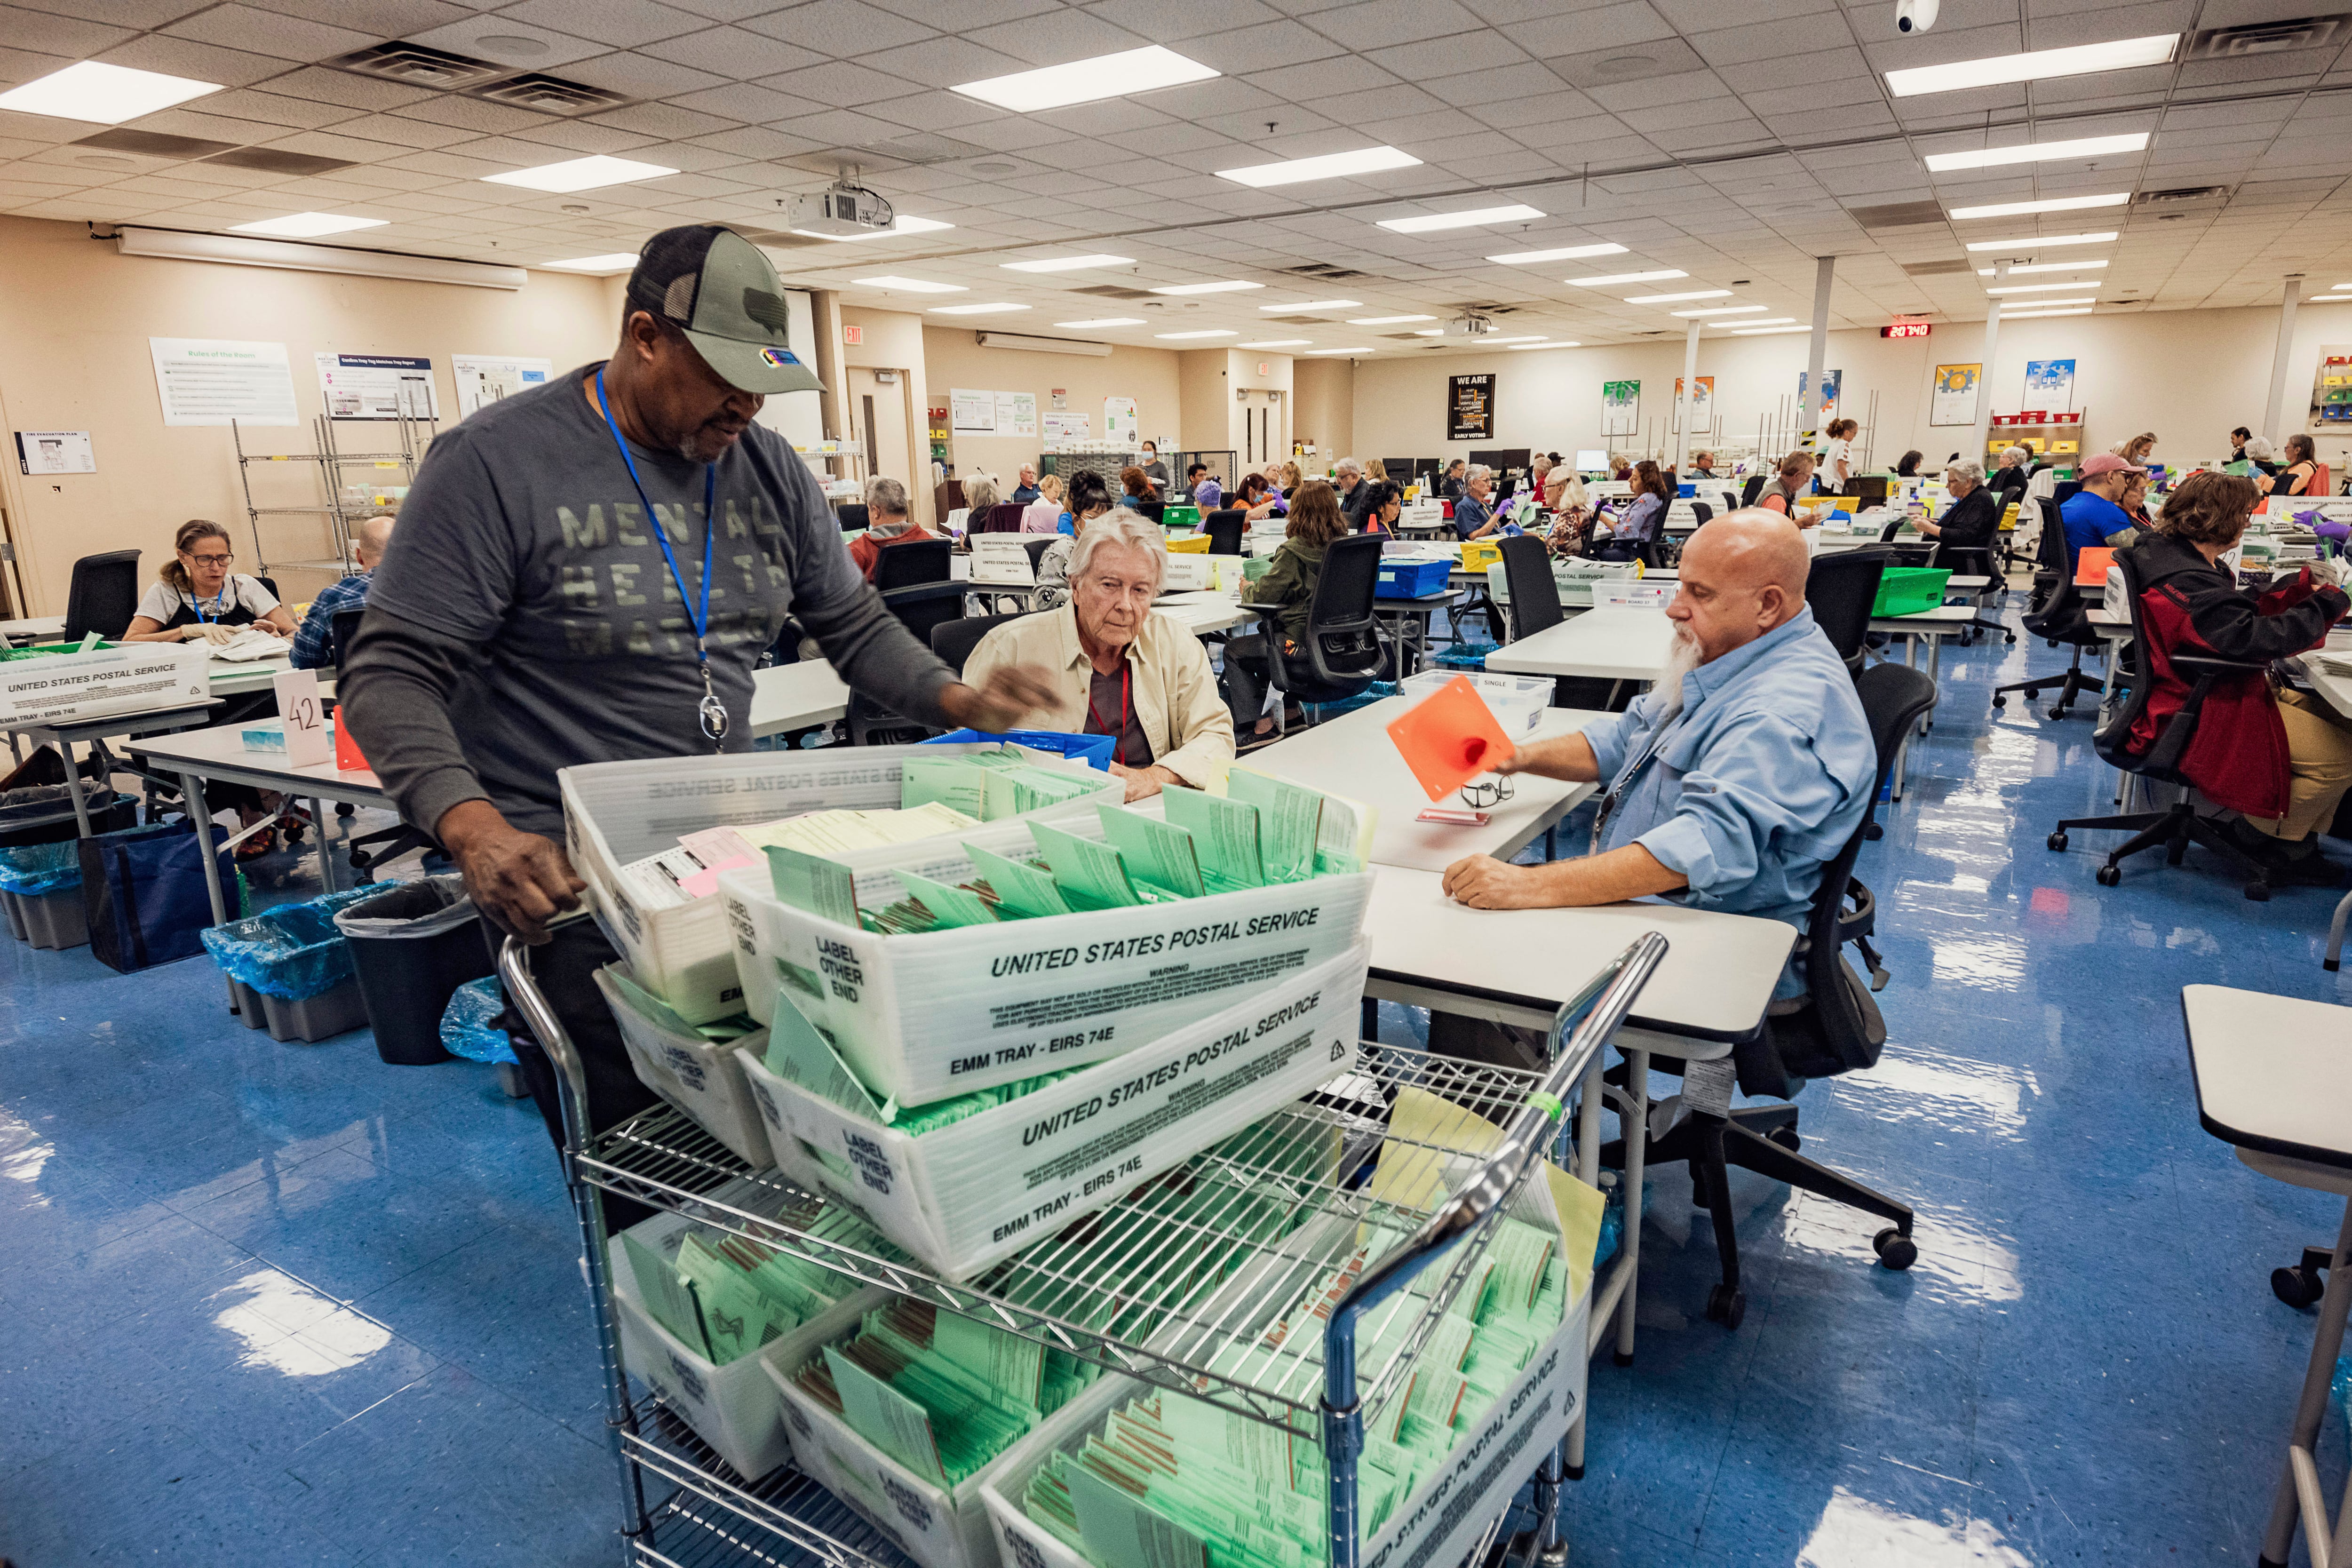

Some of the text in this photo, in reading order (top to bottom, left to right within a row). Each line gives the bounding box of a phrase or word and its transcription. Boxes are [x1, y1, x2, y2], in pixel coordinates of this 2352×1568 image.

[847, 327, 860, 342] EXIT
[1471, 375, 1487, 384] ARE
[8, 681, 48, 692] UNITED
[51, 676, 90, 687] STATES
[93, 670, 132, 681] POSTAL
[135, 664, 176, 676] SERVICE
[289, 696, 320, 731] 42
[815, 935, 859, 965] LABEL
[991, 907, 1319, 978] UNITED STATES POSTAL SERVICE
[820, 956, 864, 987] OTHER
[1150, 963, 1189, 978] WARNING
[831, 980, 858, 1003] END
[951, 1053, 990, 1075] EMM
[994, 1043, 1036, 1067] TRAY
[1049, 1034, 1085, 1055] EIRS
[1088, 1027, 1115, 1045] 74E
[1022, 992, 1322, 1147] UNITED STATES POSTAL SERVICE
[1168, 1078, 1206, 1103] WARNING
[842, 1129, 888, 1162] LABEL
[849, 1147, 894, 1182] OTHER
[861, 1170, 890, 1195] END
[993, 1213, 1031, 1243] EMM
[1034, 1192, 1072, 1224] TRAY
[1082, 1171, 1116, 1197] EIRS
[1117, 1154, 1143, 1179] 74E
[1395, 1348, 1559, 1548] STATES POSTAL SERVICE
